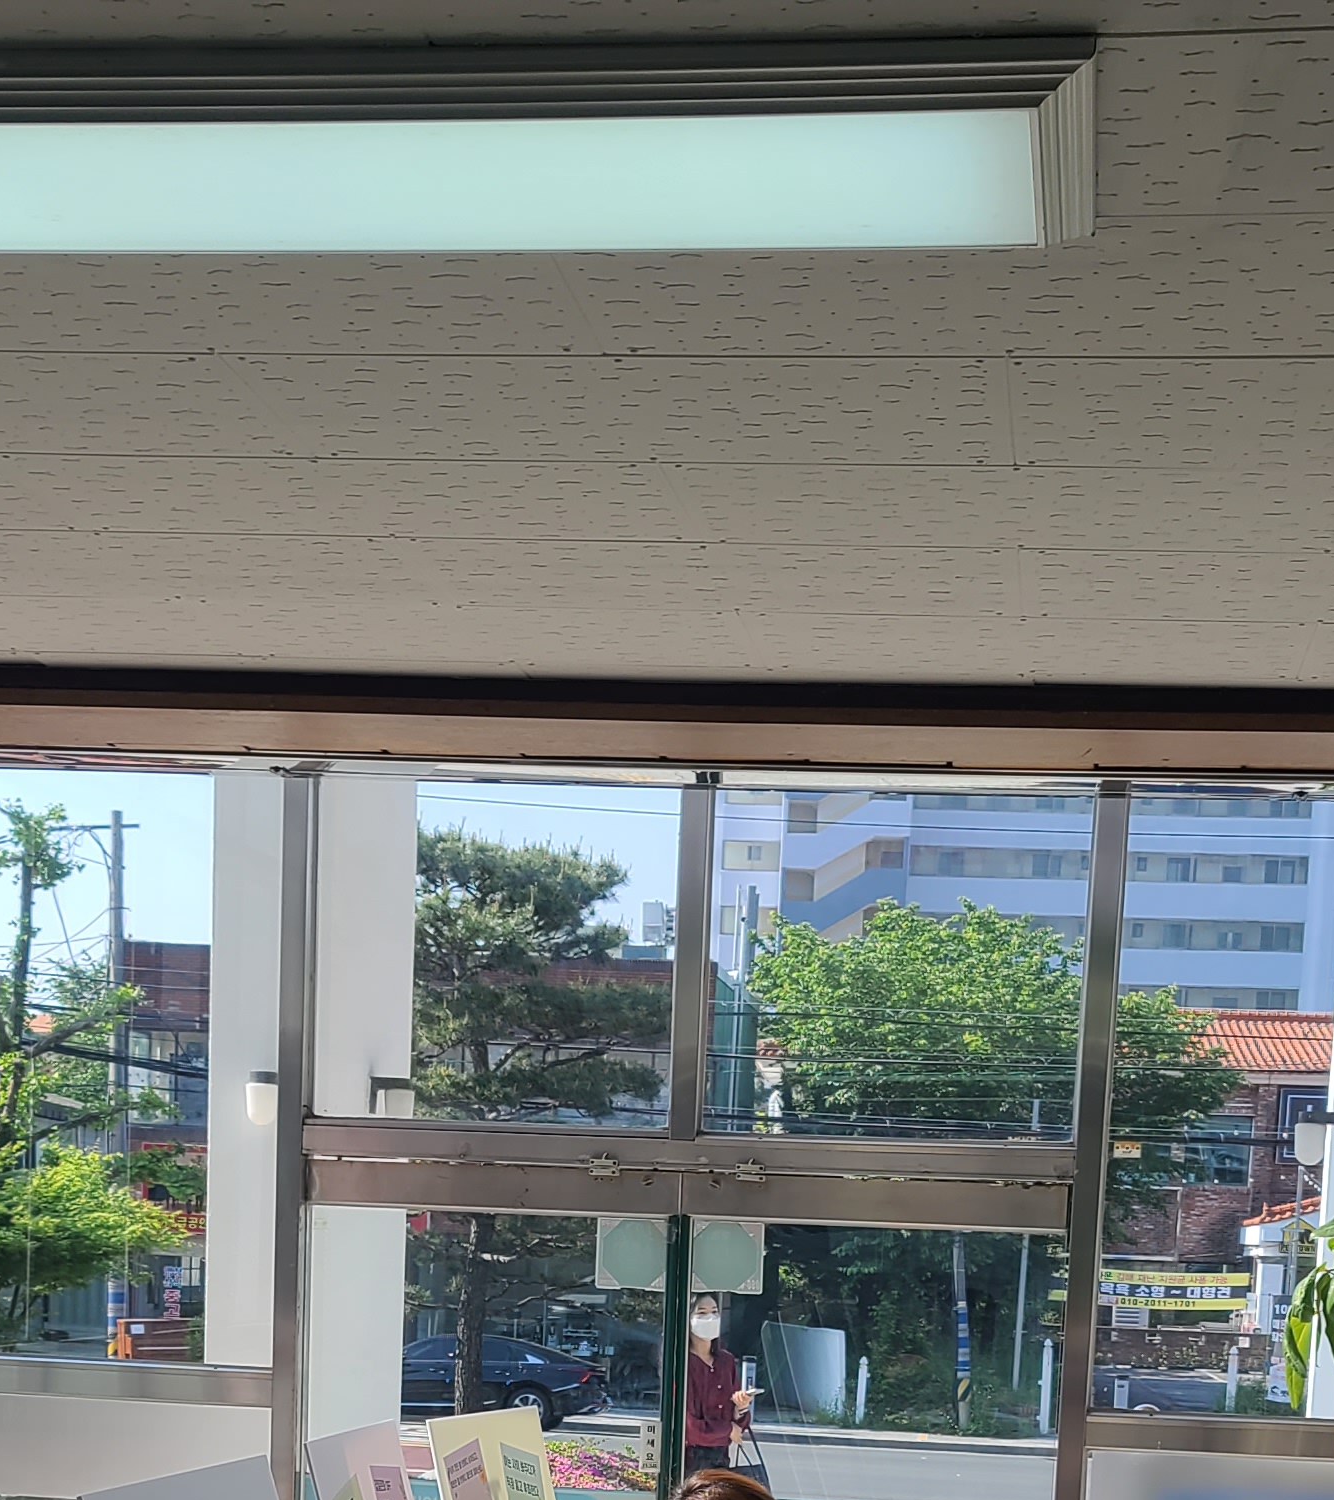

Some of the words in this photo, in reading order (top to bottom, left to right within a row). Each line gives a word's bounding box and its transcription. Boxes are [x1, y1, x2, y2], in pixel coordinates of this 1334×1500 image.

[1135, 1285, 1165, 1298] 소형
[1186, 1286, 1232, 1299] 대형견
[1120, 1298, 1196, 1308] 010-2011-1701
